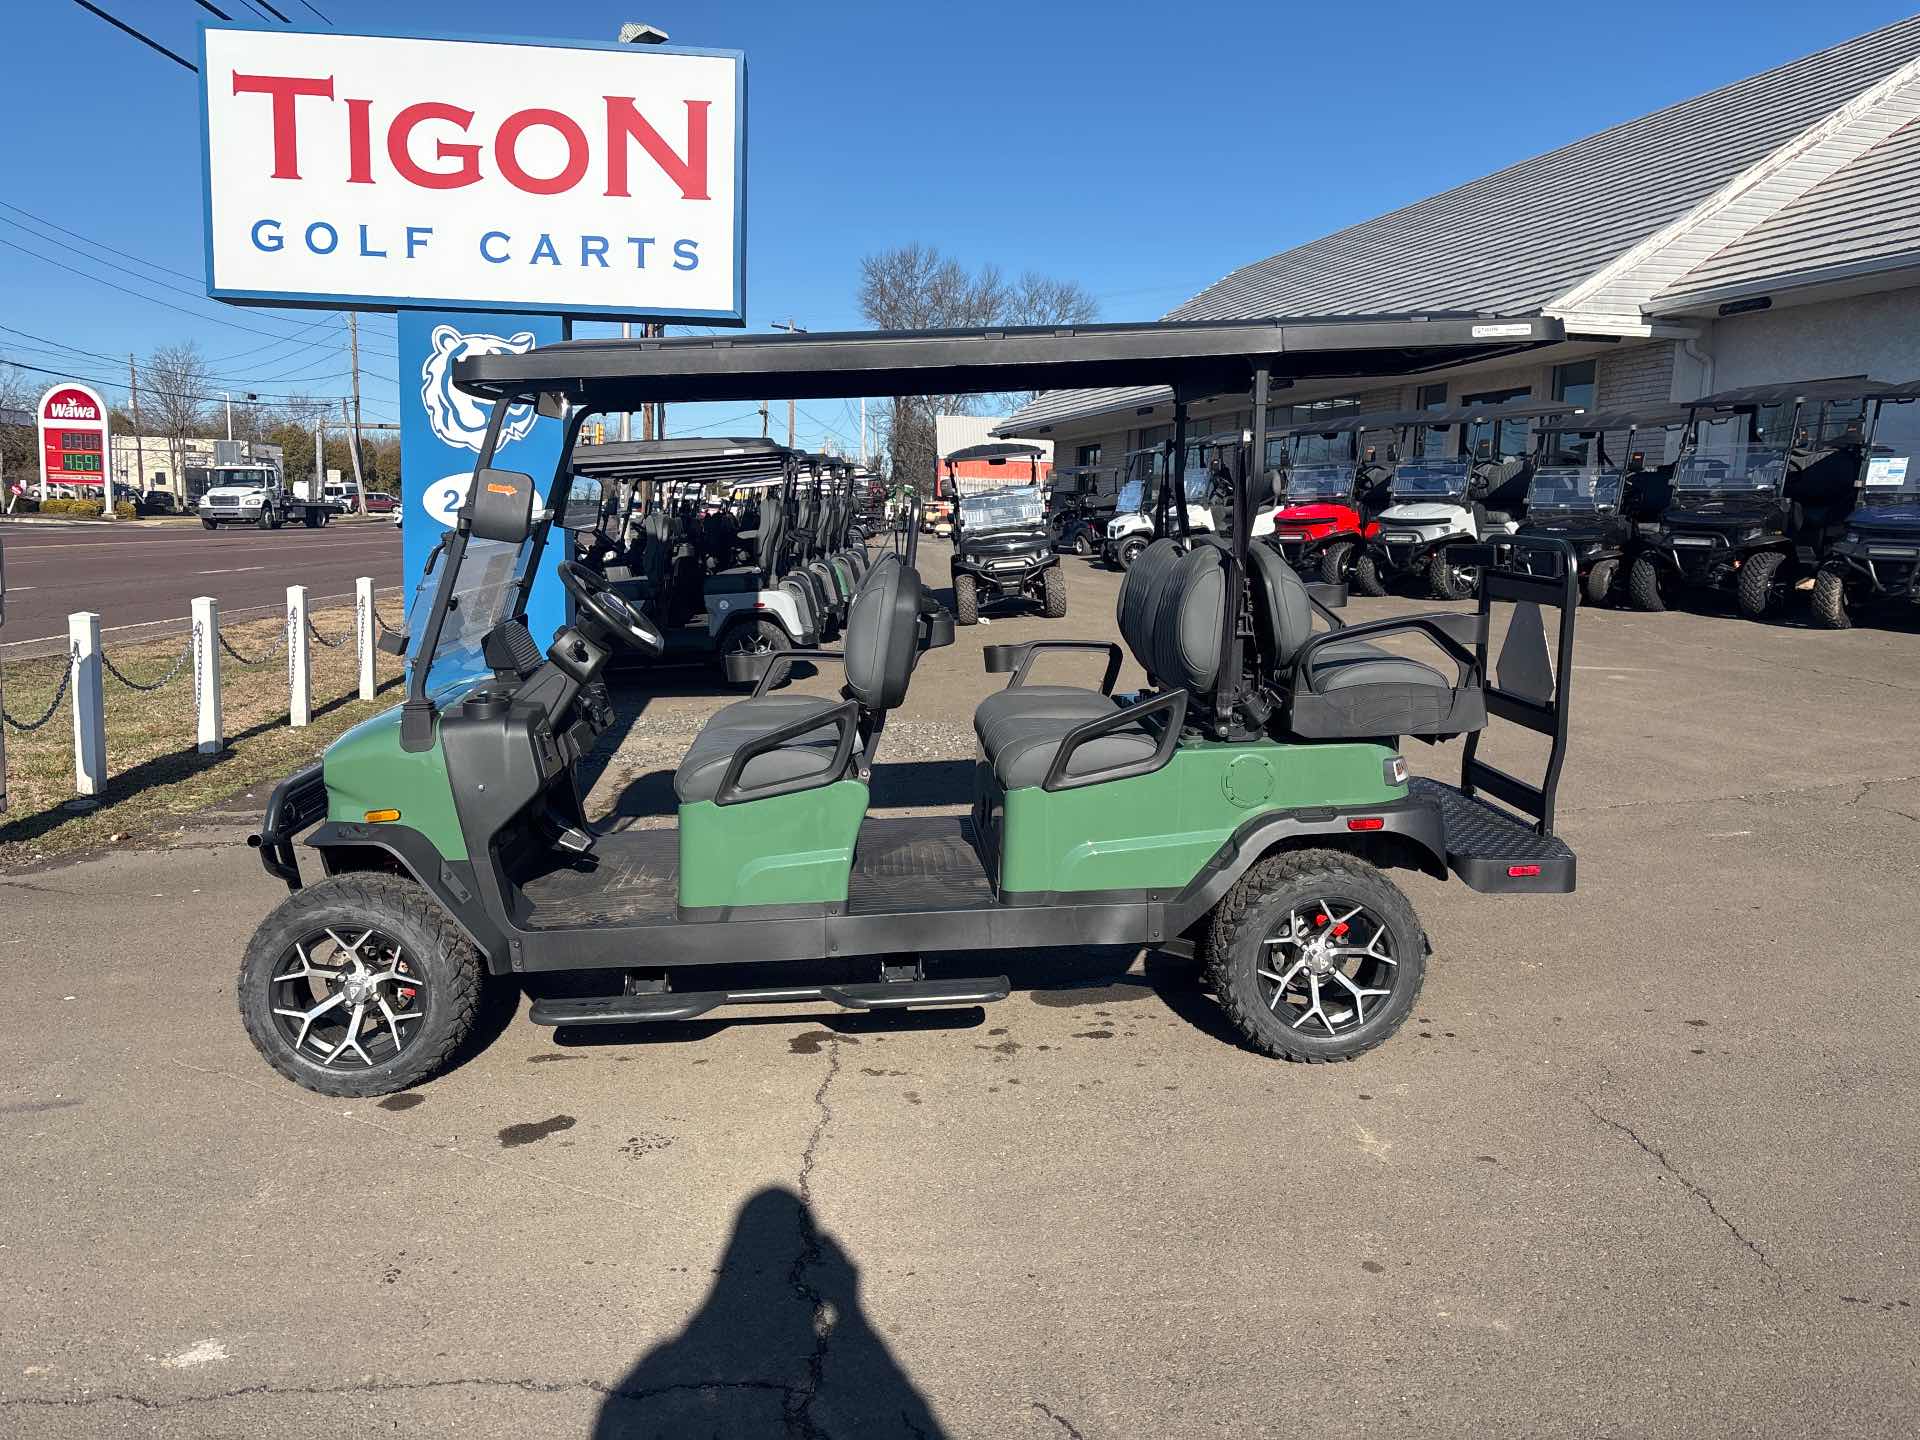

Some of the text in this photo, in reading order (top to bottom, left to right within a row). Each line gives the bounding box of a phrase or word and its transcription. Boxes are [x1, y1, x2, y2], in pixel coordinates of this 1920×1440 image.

[232, 69, 711, 201] TIGON
[250, 219, 699, 271] GOLF CARTS
[50, 403, 95, 418] Wawa
